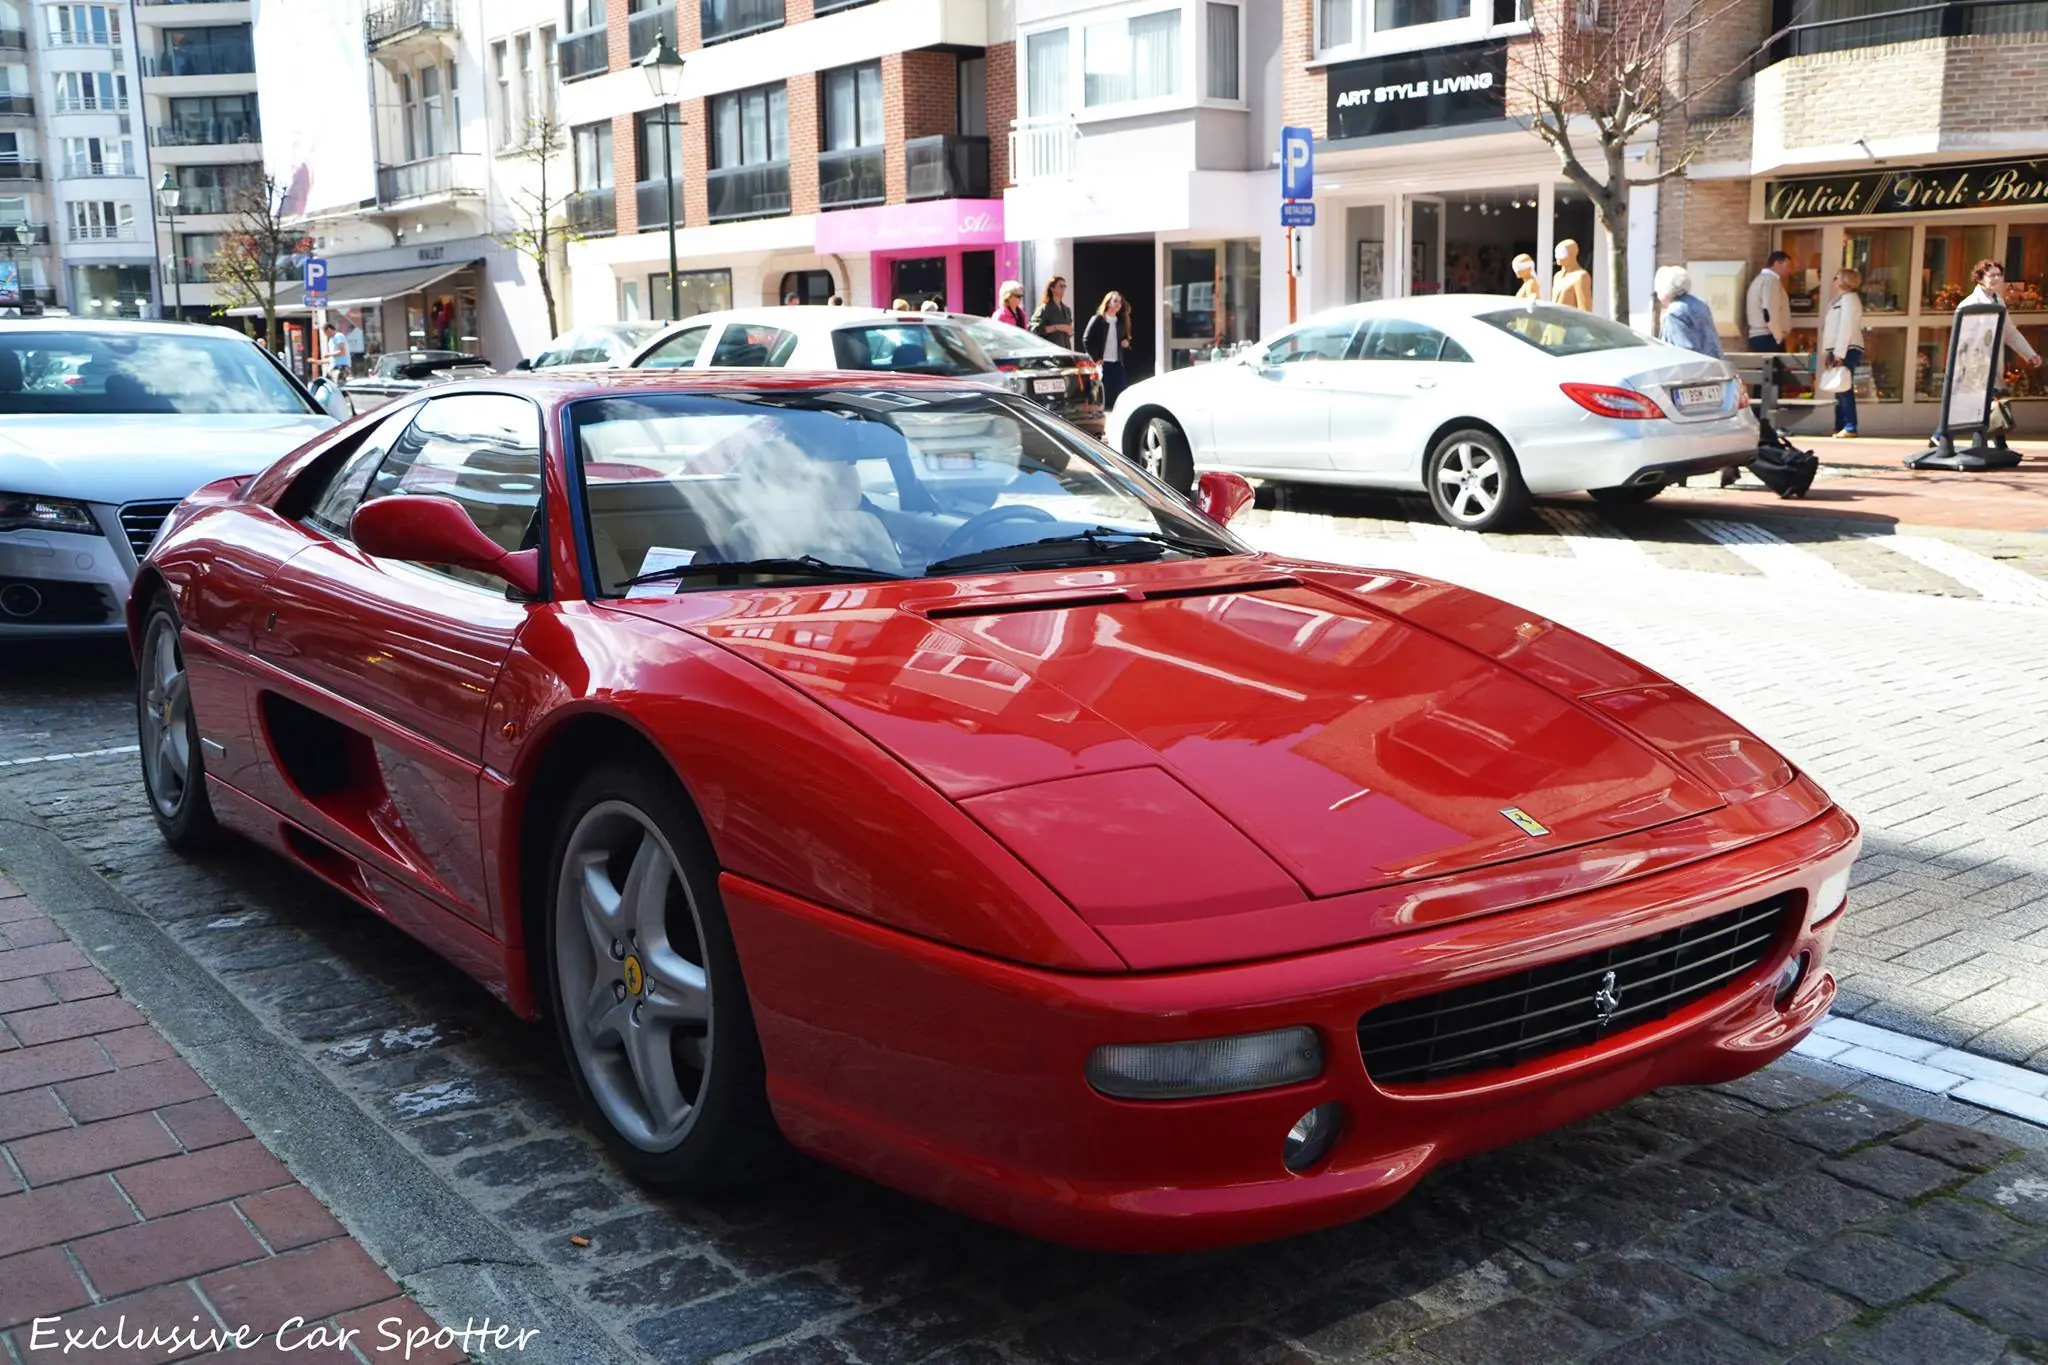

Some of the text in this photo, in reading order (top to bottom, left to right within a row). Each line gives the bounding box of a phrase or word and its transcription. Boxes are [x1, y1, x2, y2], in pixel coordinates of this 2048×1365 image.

[1336, 72, 1493, 108] ART STYLE LIVING
[1287, 138, 1309, 188] P
[1769, 181, 1861, 220] Optiek
[1893, 172, 1969, 208] Dirk
[307, 263, 325, 287] P
